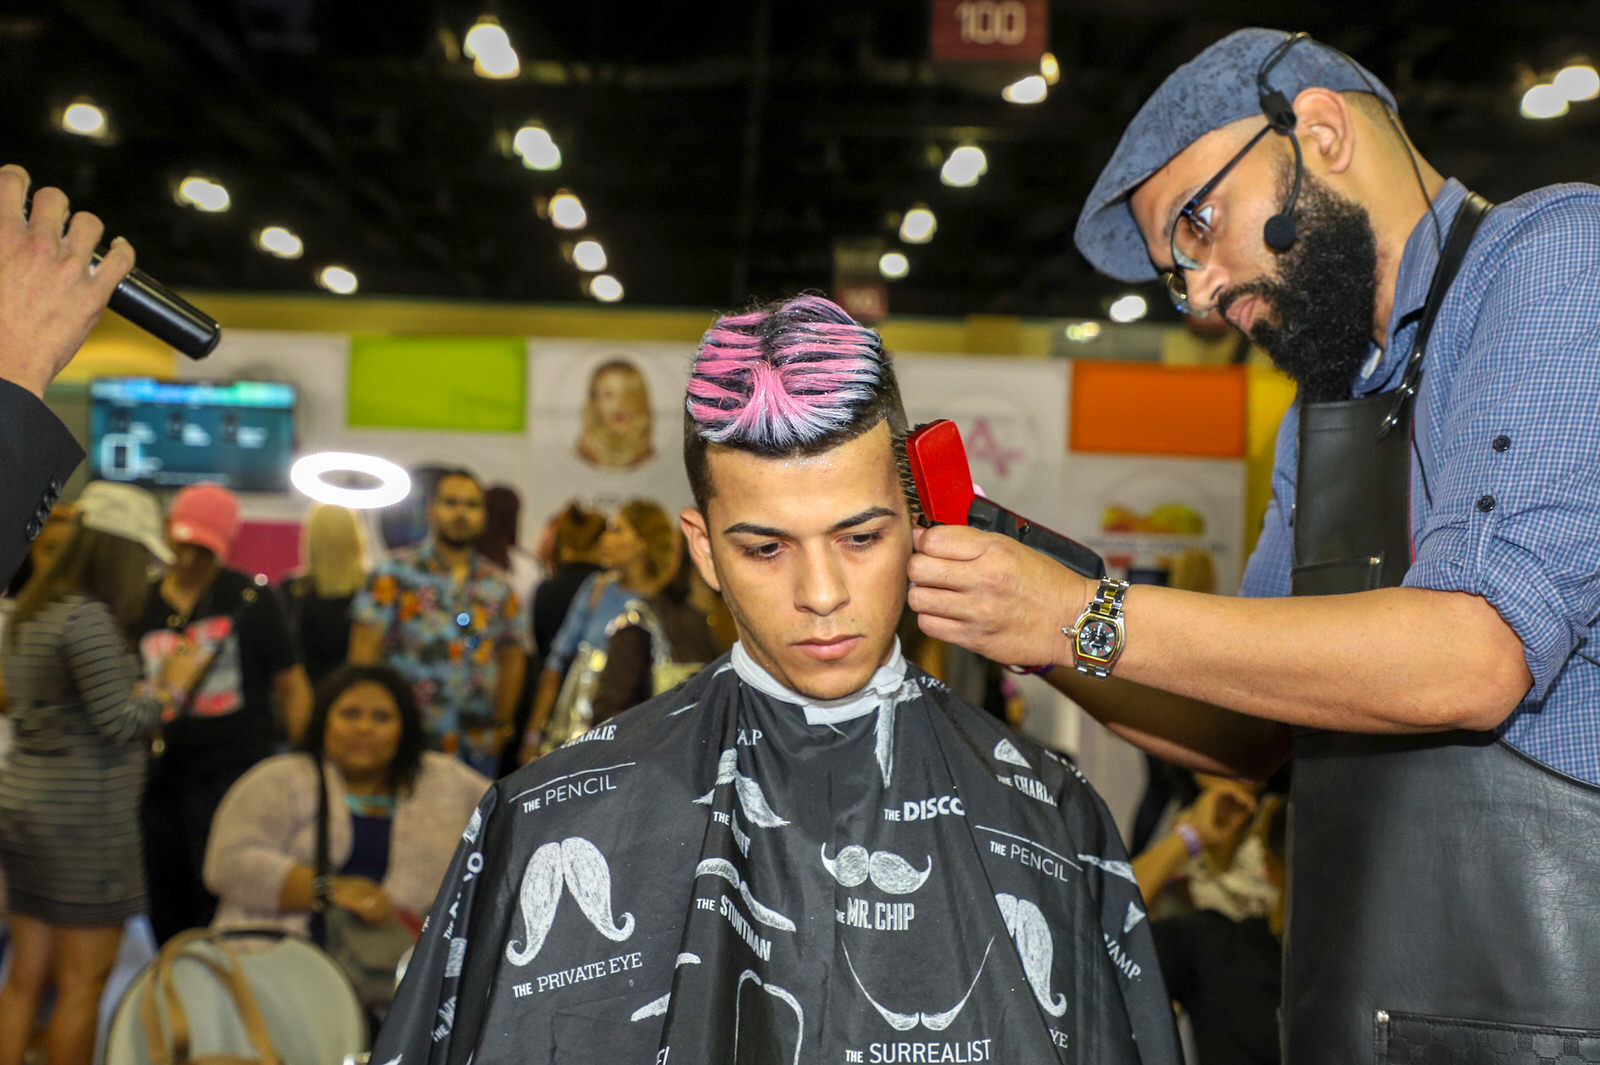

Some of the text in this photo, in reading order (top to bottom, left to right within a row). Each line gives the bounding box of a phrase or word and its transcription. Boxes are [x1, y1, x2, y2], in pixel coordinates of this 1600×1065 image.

[955, 1, 1027, 45] 100
[523, 774, 617, 814] THE PENCIL
[712, 811, 731, 826] THE
[884, 808, 901, 822] THE
[990, 840, 1069, 882] THE PENCIL
[696, 894, 772, 962] THE STUNTMAN
[846, 897, 873, 929] MR.
[874, 902, 915, 931] CHIP
[512, 951, 643, 998] THE PRIVATE EYE
[845, 1039, 992, 1064] THE SURREALIST
